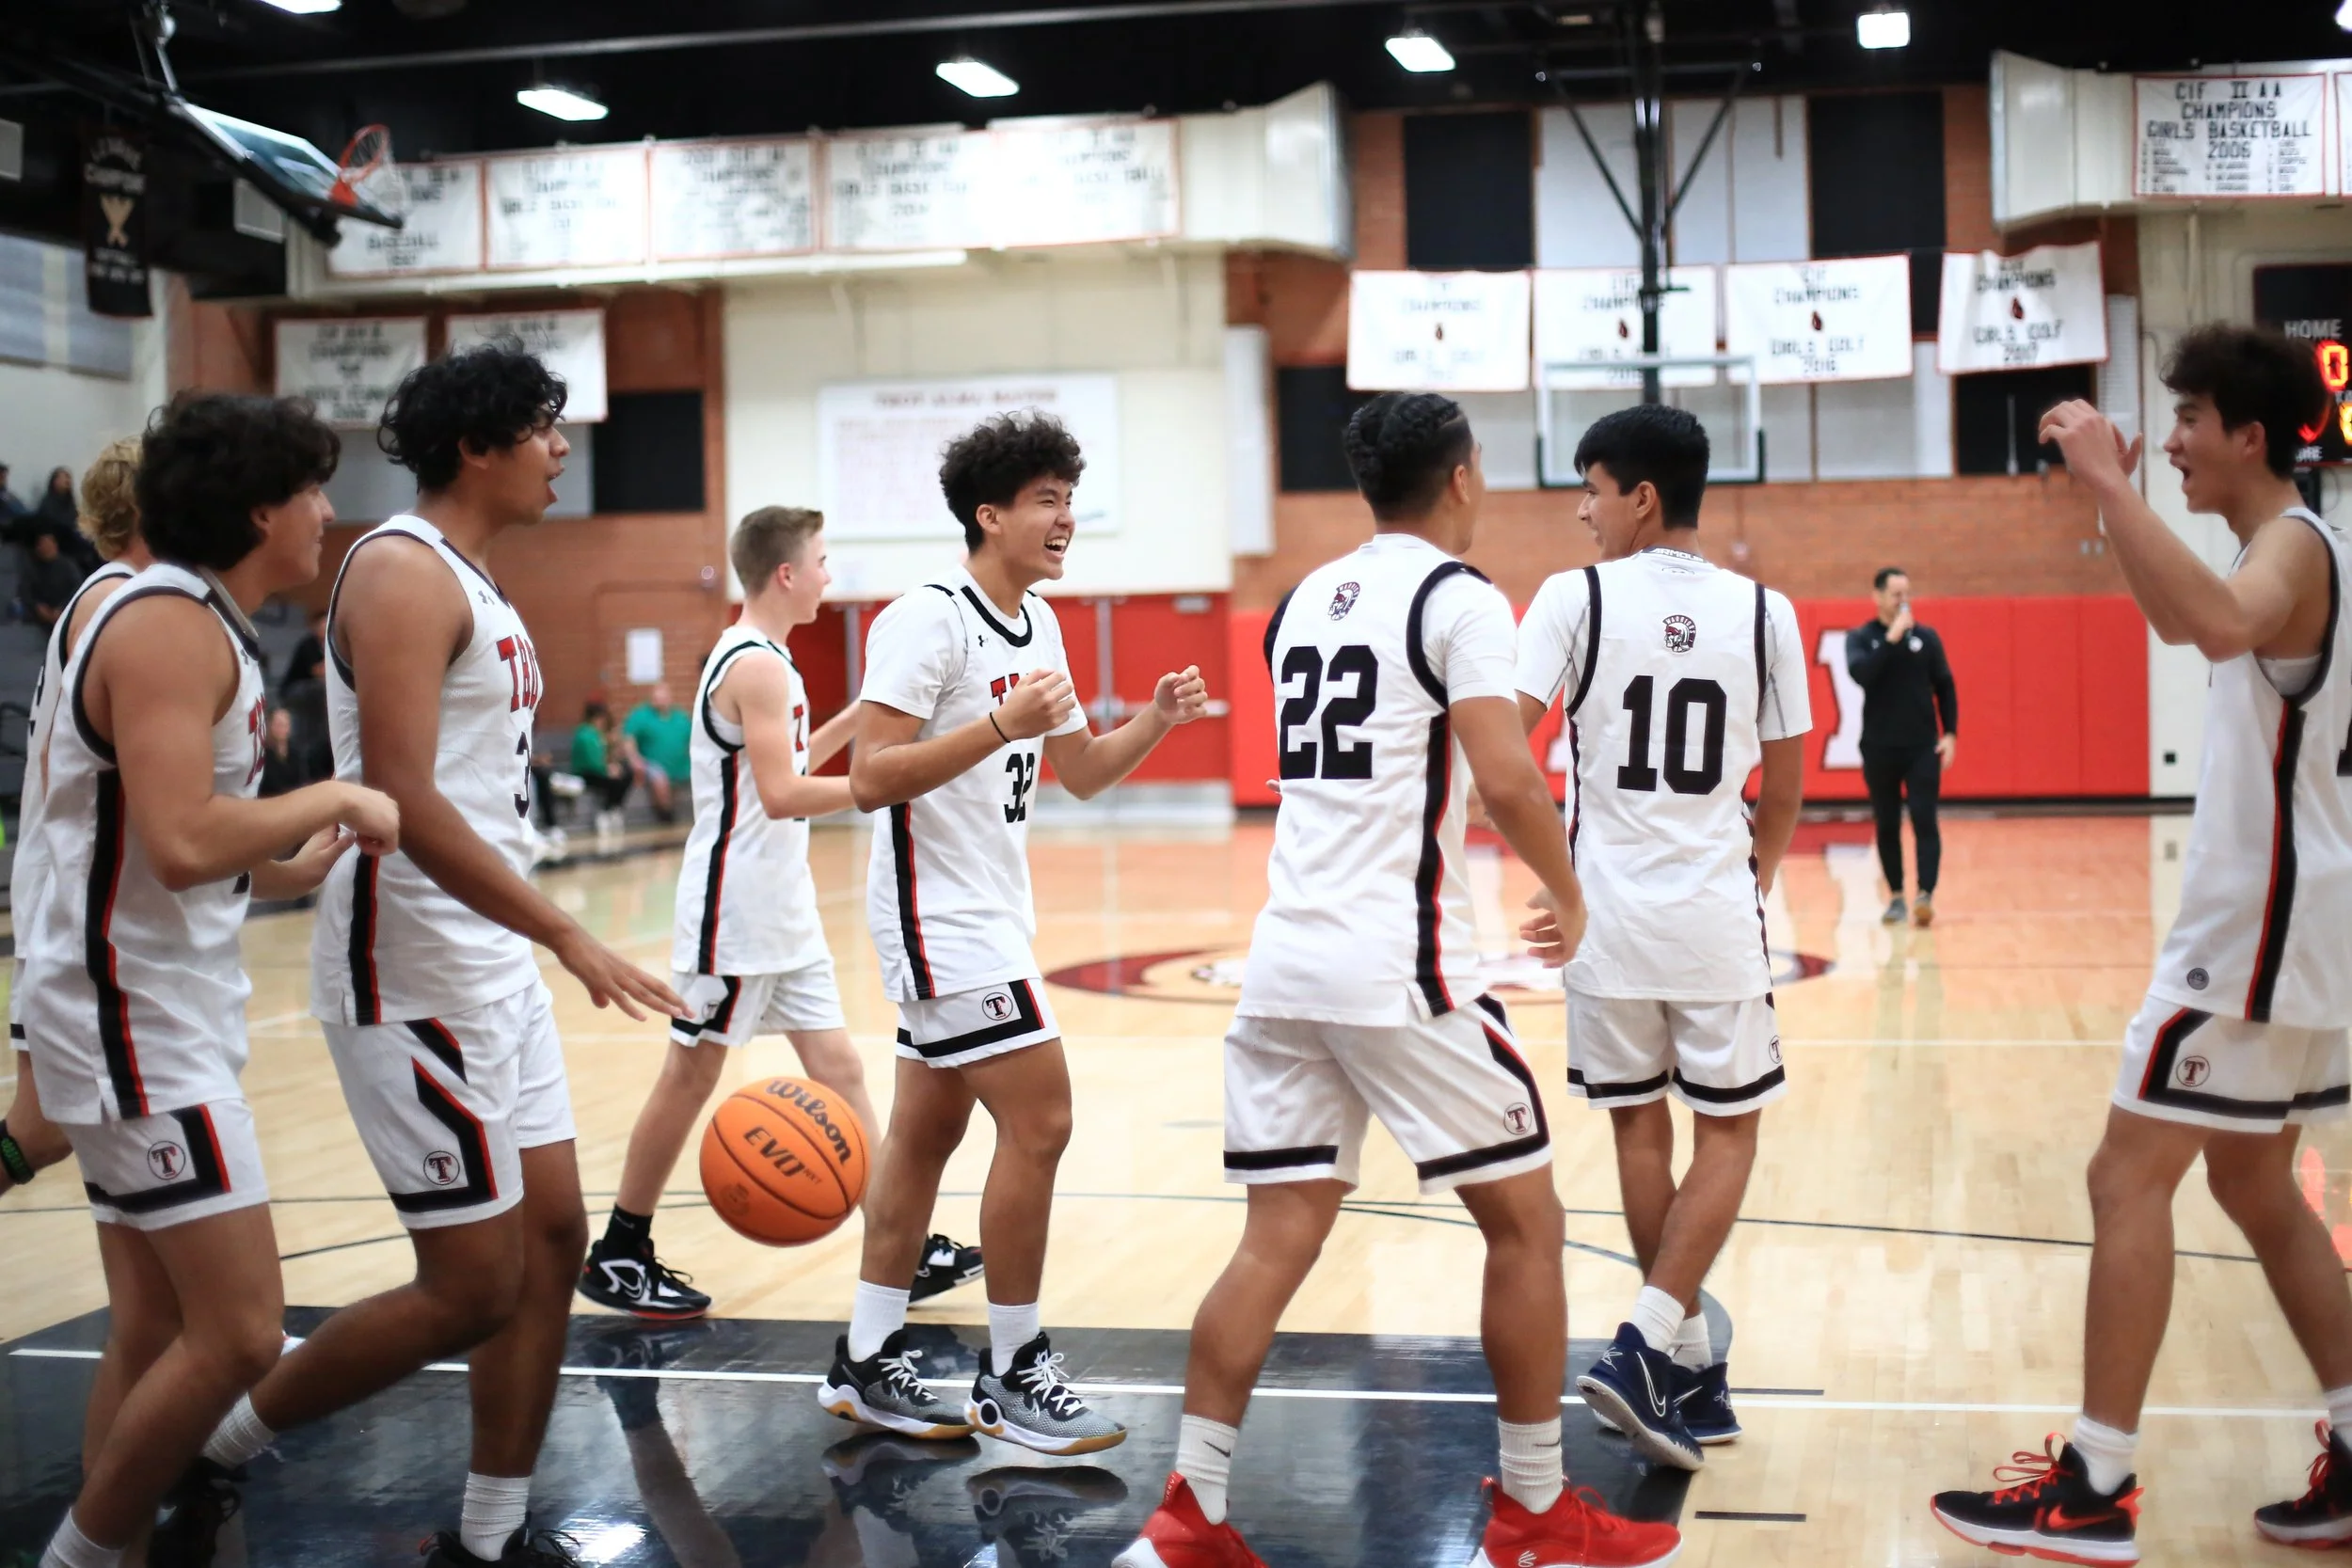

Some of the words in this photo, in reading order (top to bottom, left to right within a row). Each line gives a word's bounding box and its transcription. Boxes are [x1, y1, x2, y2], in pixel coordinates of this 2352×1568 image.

[2175, 81, 2206, 100] CIF
[2181, 101, 2278, 119] CHAMPIONS
[2147, 120, 2194, 139] GIRLS
[2207, 119, 2312, 139] BASKETBALL
[2207, 141, 2251, 159] 2006
[1774, 286, 1860, 305] CHAMPIONS
[2284, 318, 2343, 340] HOME
[1279, 645, 1379, 780] 22
[1617, 674, 1727, 796] 10
[1004, 752, 1036, 824] 32
[765, 1080, 851, 1166] Wilson
[743, 1127, 805, 1178] EVO
